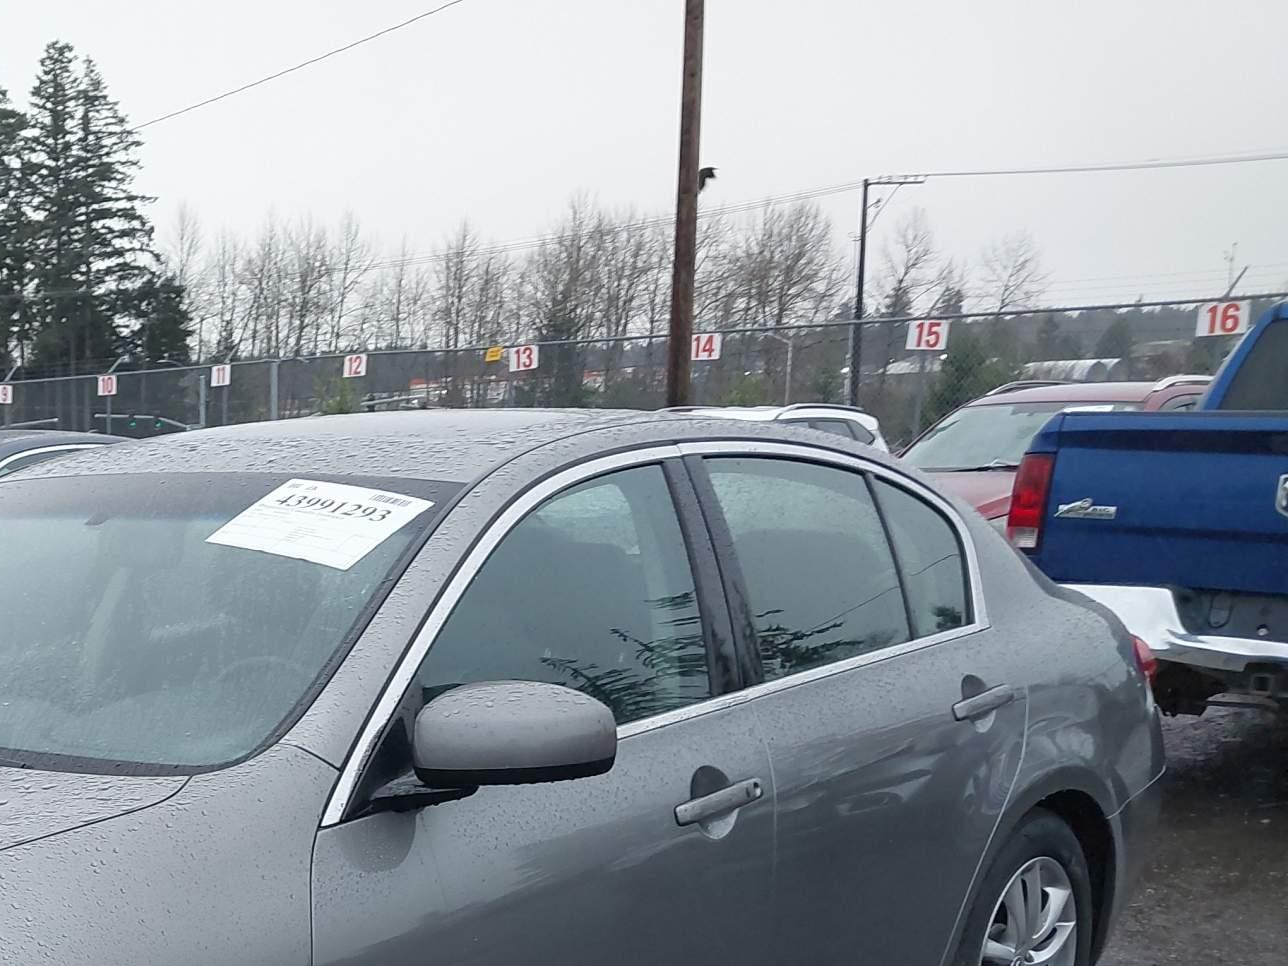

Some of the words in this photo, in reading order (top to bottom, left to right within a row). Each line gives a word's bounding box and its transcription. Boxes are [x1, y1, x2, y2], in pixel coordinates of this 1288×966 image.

[1207, 303, 1241, 334] 16
[694, 335, 715, 358] 14
[915, 322, 941, 348] 15
[348, 355, 361, 375] 12
[514, 347, 533, 369] 13
[276, 494, 392, 522] 43991293
